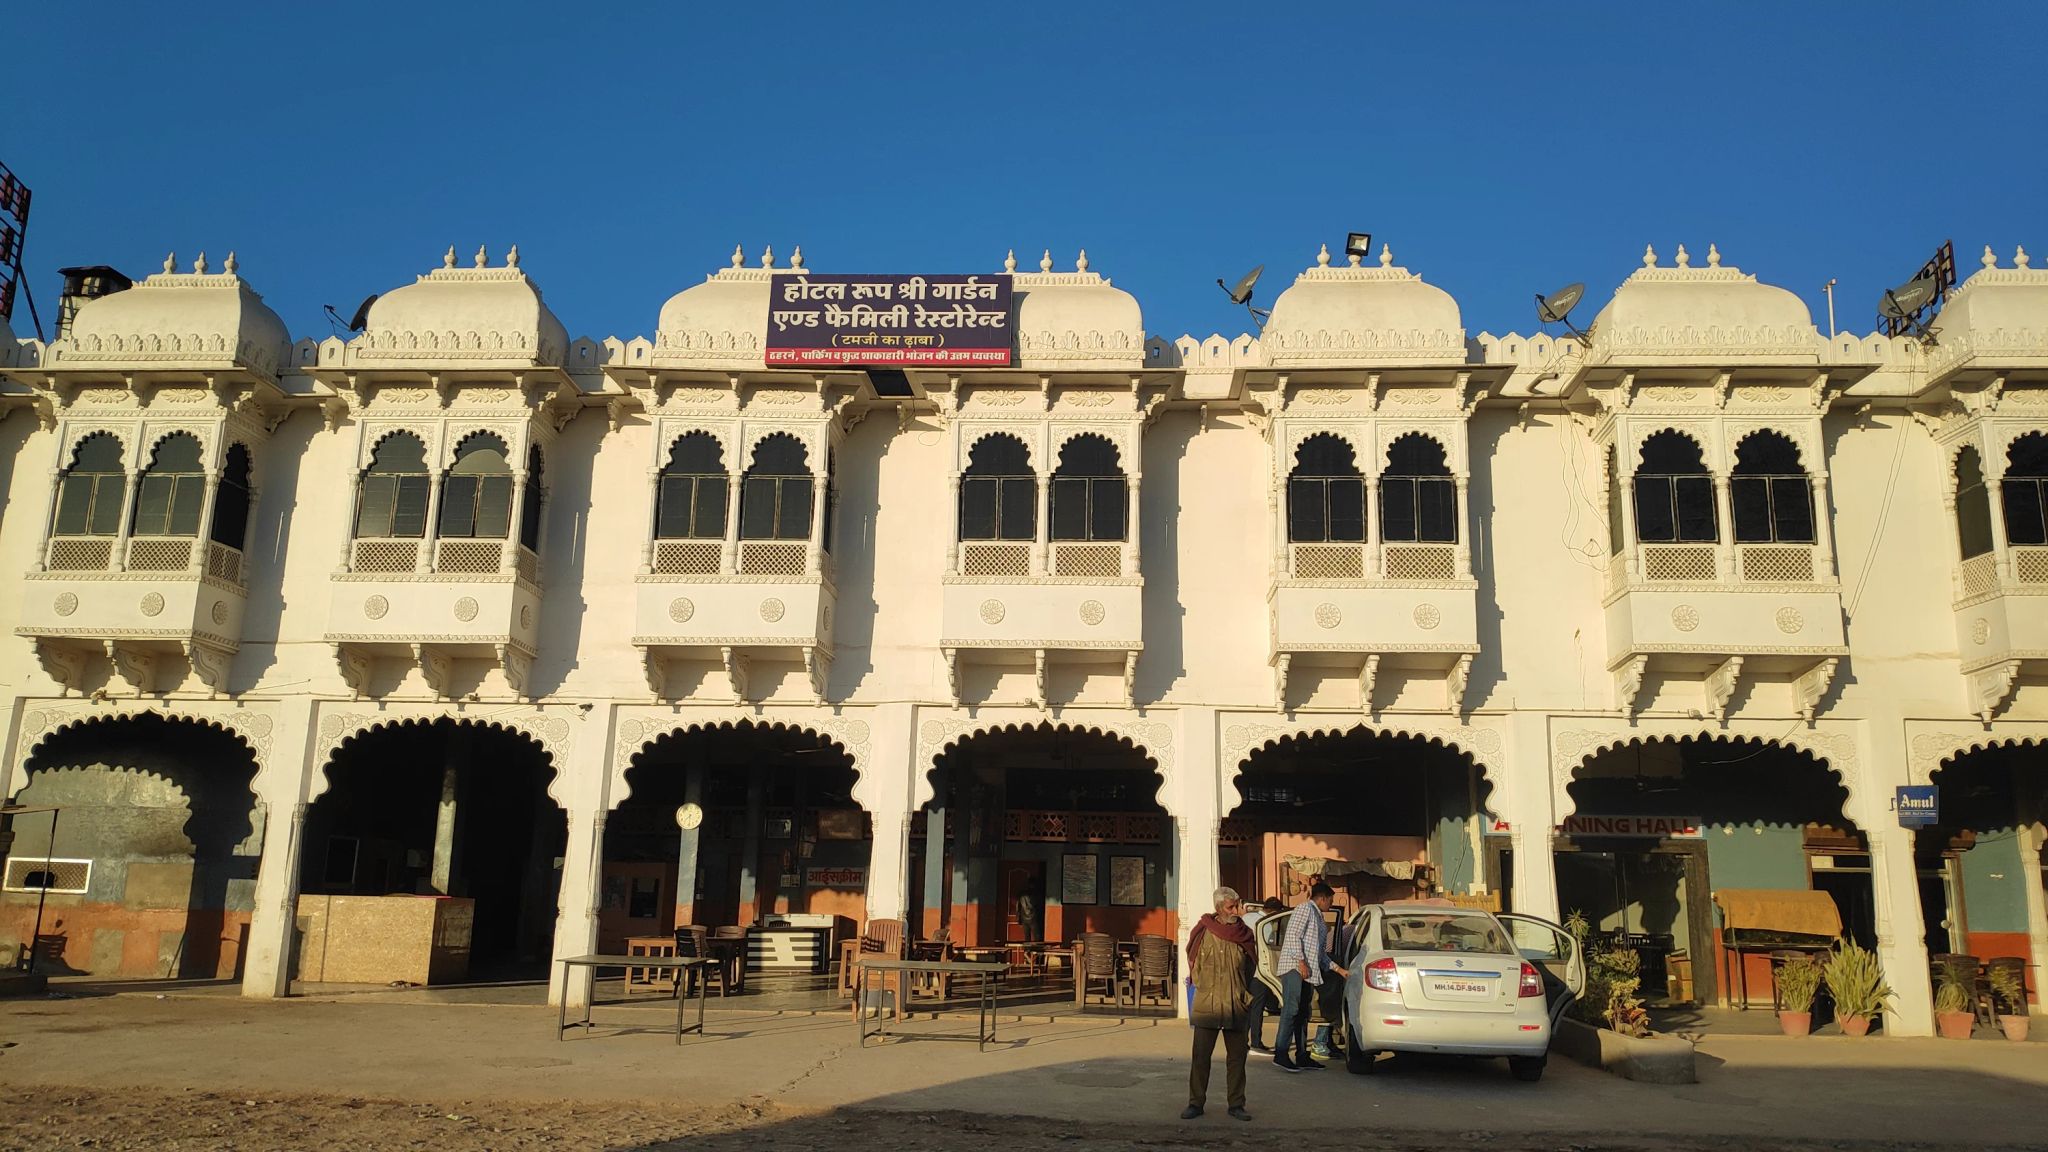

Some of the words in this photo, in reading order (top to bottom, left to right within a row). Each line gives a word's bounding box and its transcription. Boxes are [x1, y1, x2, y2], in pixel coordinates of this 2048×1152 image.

[784, 276, 847, 302] होटल
[851, 283, 893, 300] रूप
[898, 276, 927, 300] श्री
[932, 276, 998, 300] गार्डन
[773, 311, 820, 332] एण्ड
[824, 303, 909, 328] फैमिली
[914, 304, 1006, 328] रेस्टोरेन्ट
[881, 335, 901, 346] का
[834, 351, 841, 360] व
[861, 350, 905, 360] शाकाहारी
[906, 350, 934, 360] भोजन
[935, 350, 949, 360] की
[972, 351, 1006, 360] व्यवस्था
[1900, 794, 1934, 809] Amul
[1636, 817, 1697, 834] HALL
[808, 868, 863, 885] आईसक्रीम
